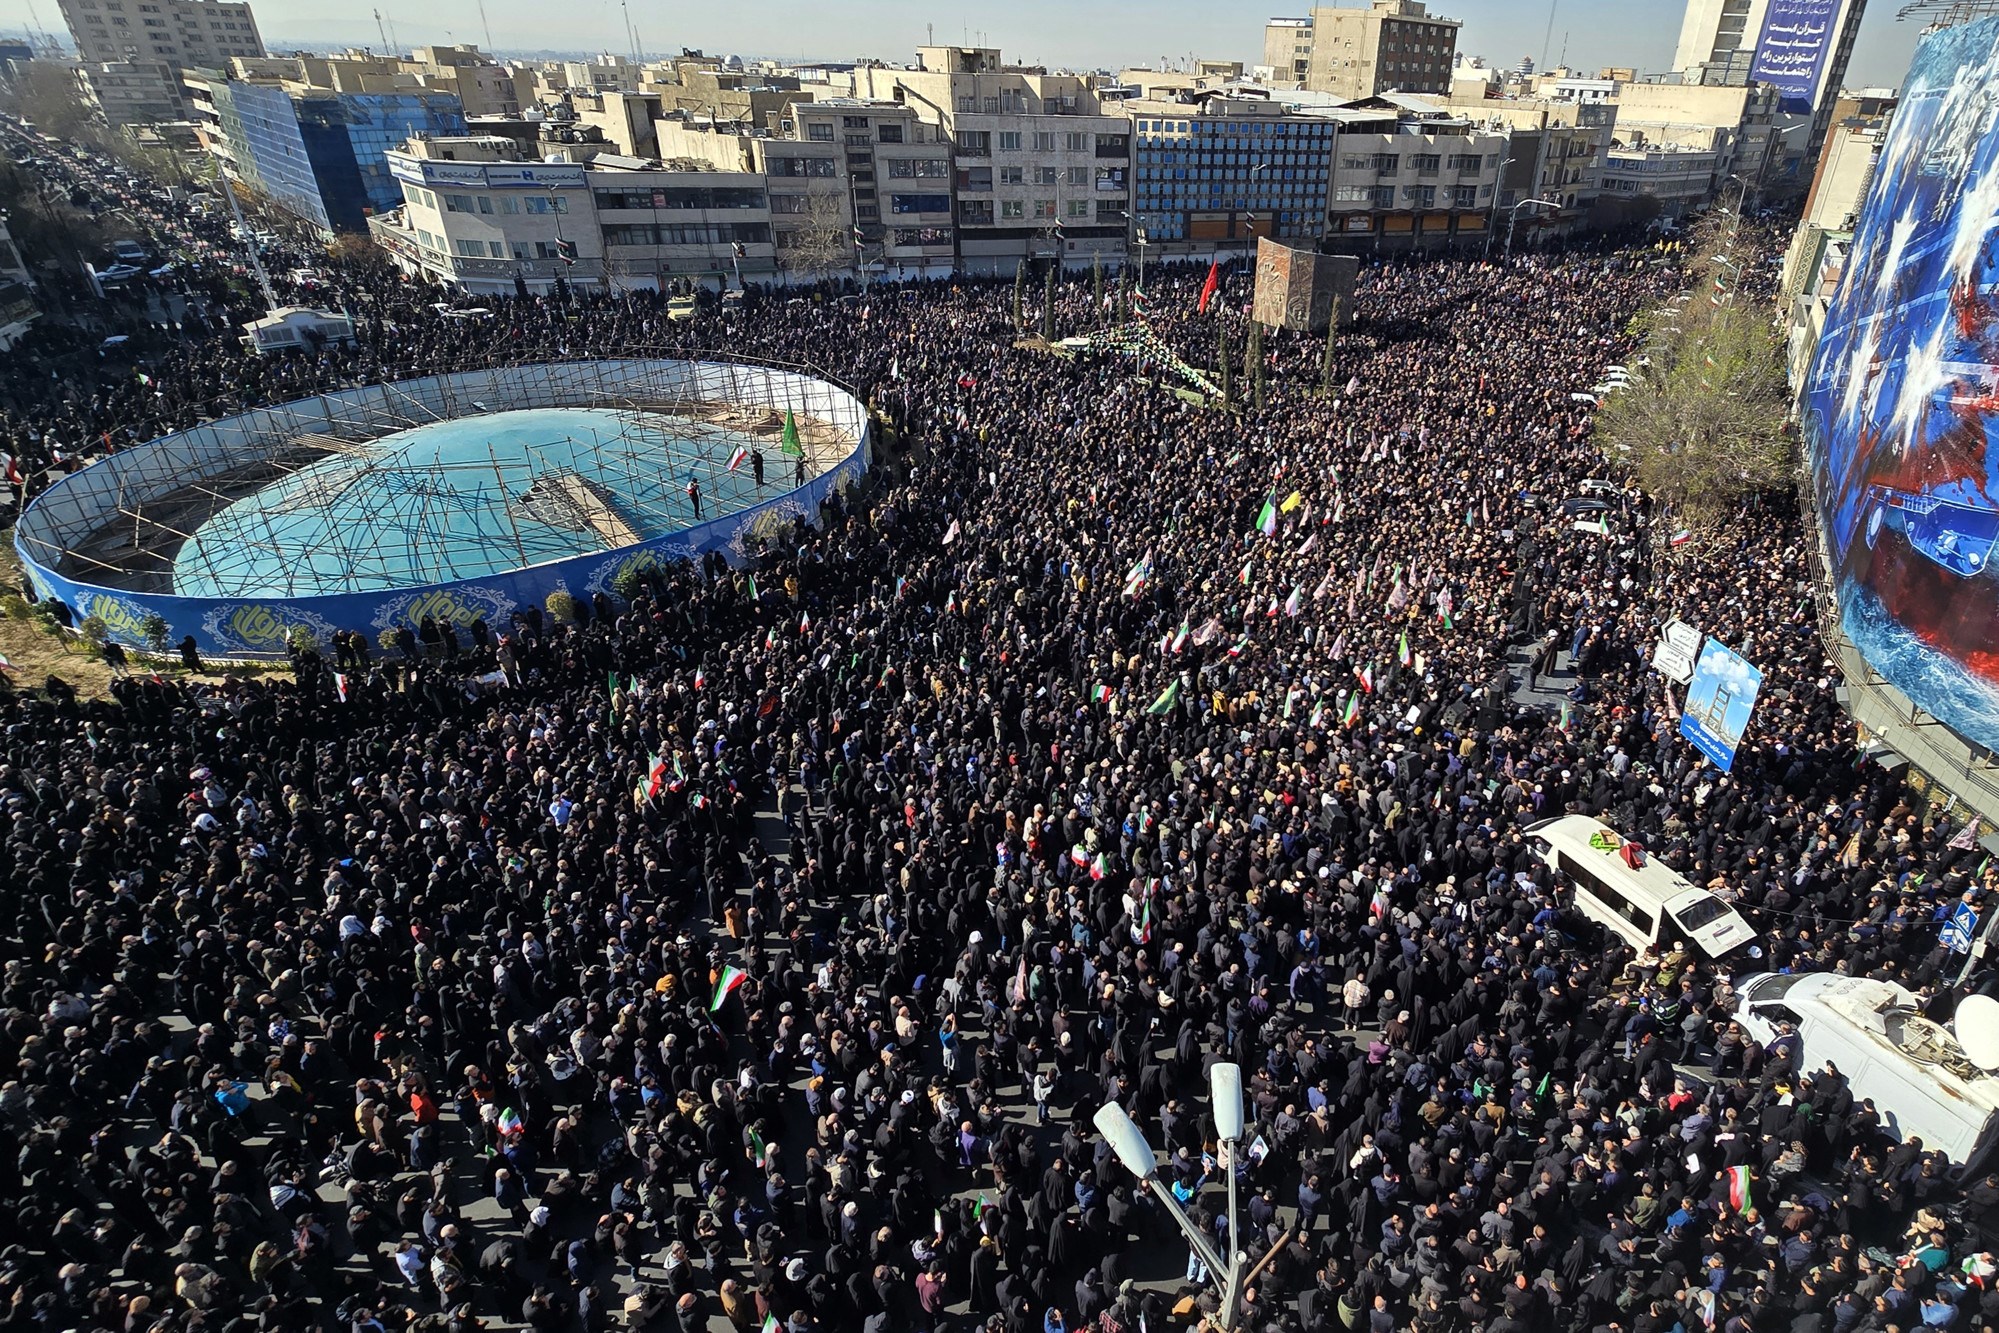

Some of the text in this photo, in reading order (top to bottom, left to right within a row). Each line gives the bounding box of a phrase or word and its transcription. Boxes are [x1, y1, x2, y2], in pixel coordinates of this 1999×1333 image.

[1769, 21, 1826, 36] قرآن است
[1765, 36, 1822, 49] که به
[1761, 50, 1817, 64] استوارترین راه
